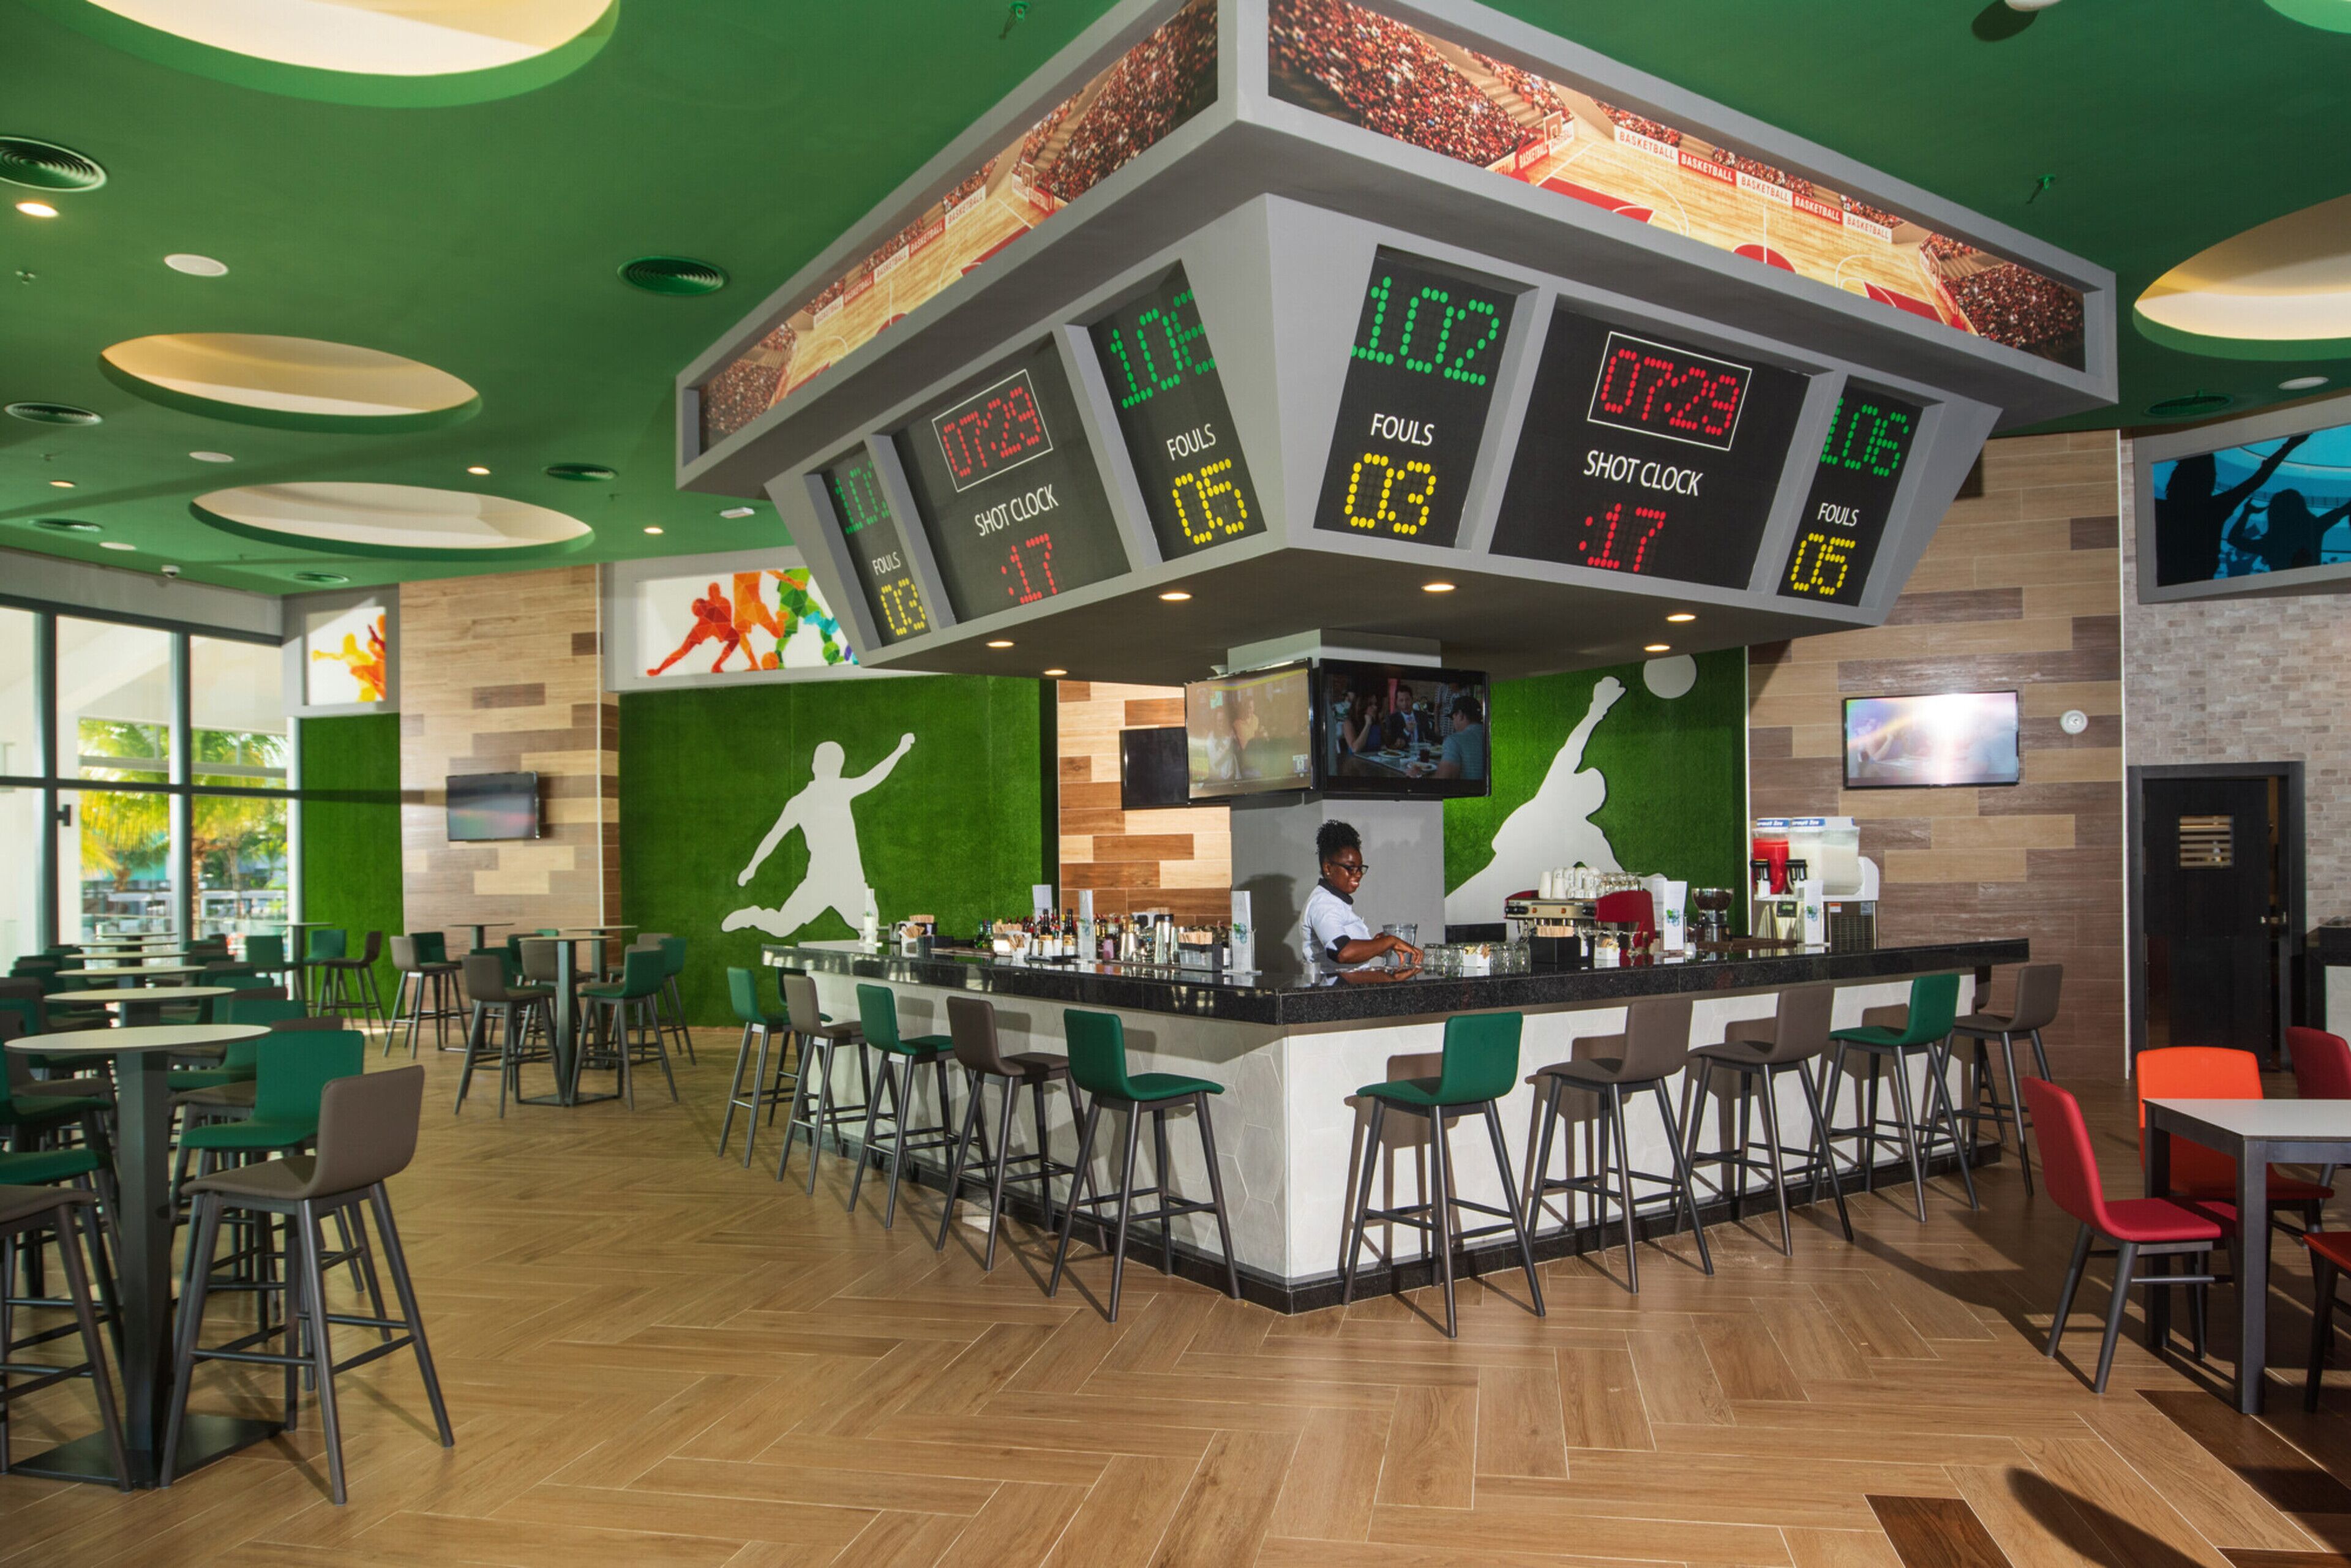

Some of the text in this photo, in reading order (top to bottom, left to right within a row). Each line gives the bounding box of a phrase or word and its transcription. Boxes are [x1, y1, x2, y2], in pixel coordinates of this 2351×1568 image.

[1619, 131, 1674, 160] BASKETBALL
[1681, 153, 1733, 182] BASKETBALL
[948, 191, 983, 225] BASKETBALL
[1741, 176, 1788, 203] BASKETBALL
[1794, 197, 1840, 222] BASKETBALL
[910, 221, 943, 254] BASKETBALL
[1847, 212, 1889, 240] BASKETBALL
[876, 251, 907, 279] BASKETBALL
[1350, 276, 1500, 386] 102
[1599, 347, 1741, 437] 07:29
[943, 386, 1041, 478] 07:29
[1166, 423, 1217, 461] FOULS
[1370, 412, 1435, 447] FOULS
[1820, 397, 1910, 477] 106
[1344, 452, 1437, 535] 03
[1583, 449, 1704, 497] SHOT CLOCK
[974, 483, 1059, 537] SHOT CLOCK
[1172, 457, 1248, 546] 05
[1817, 502, 1860, 527] FOULS
[1578, 502, 1667, 573] :17
[872, 551, 901, 576] FOULS
[1000, 533, 1058, 605] :17
[1790, 533, 1856, 596] 05
[880, 577, 926, 636] 03
